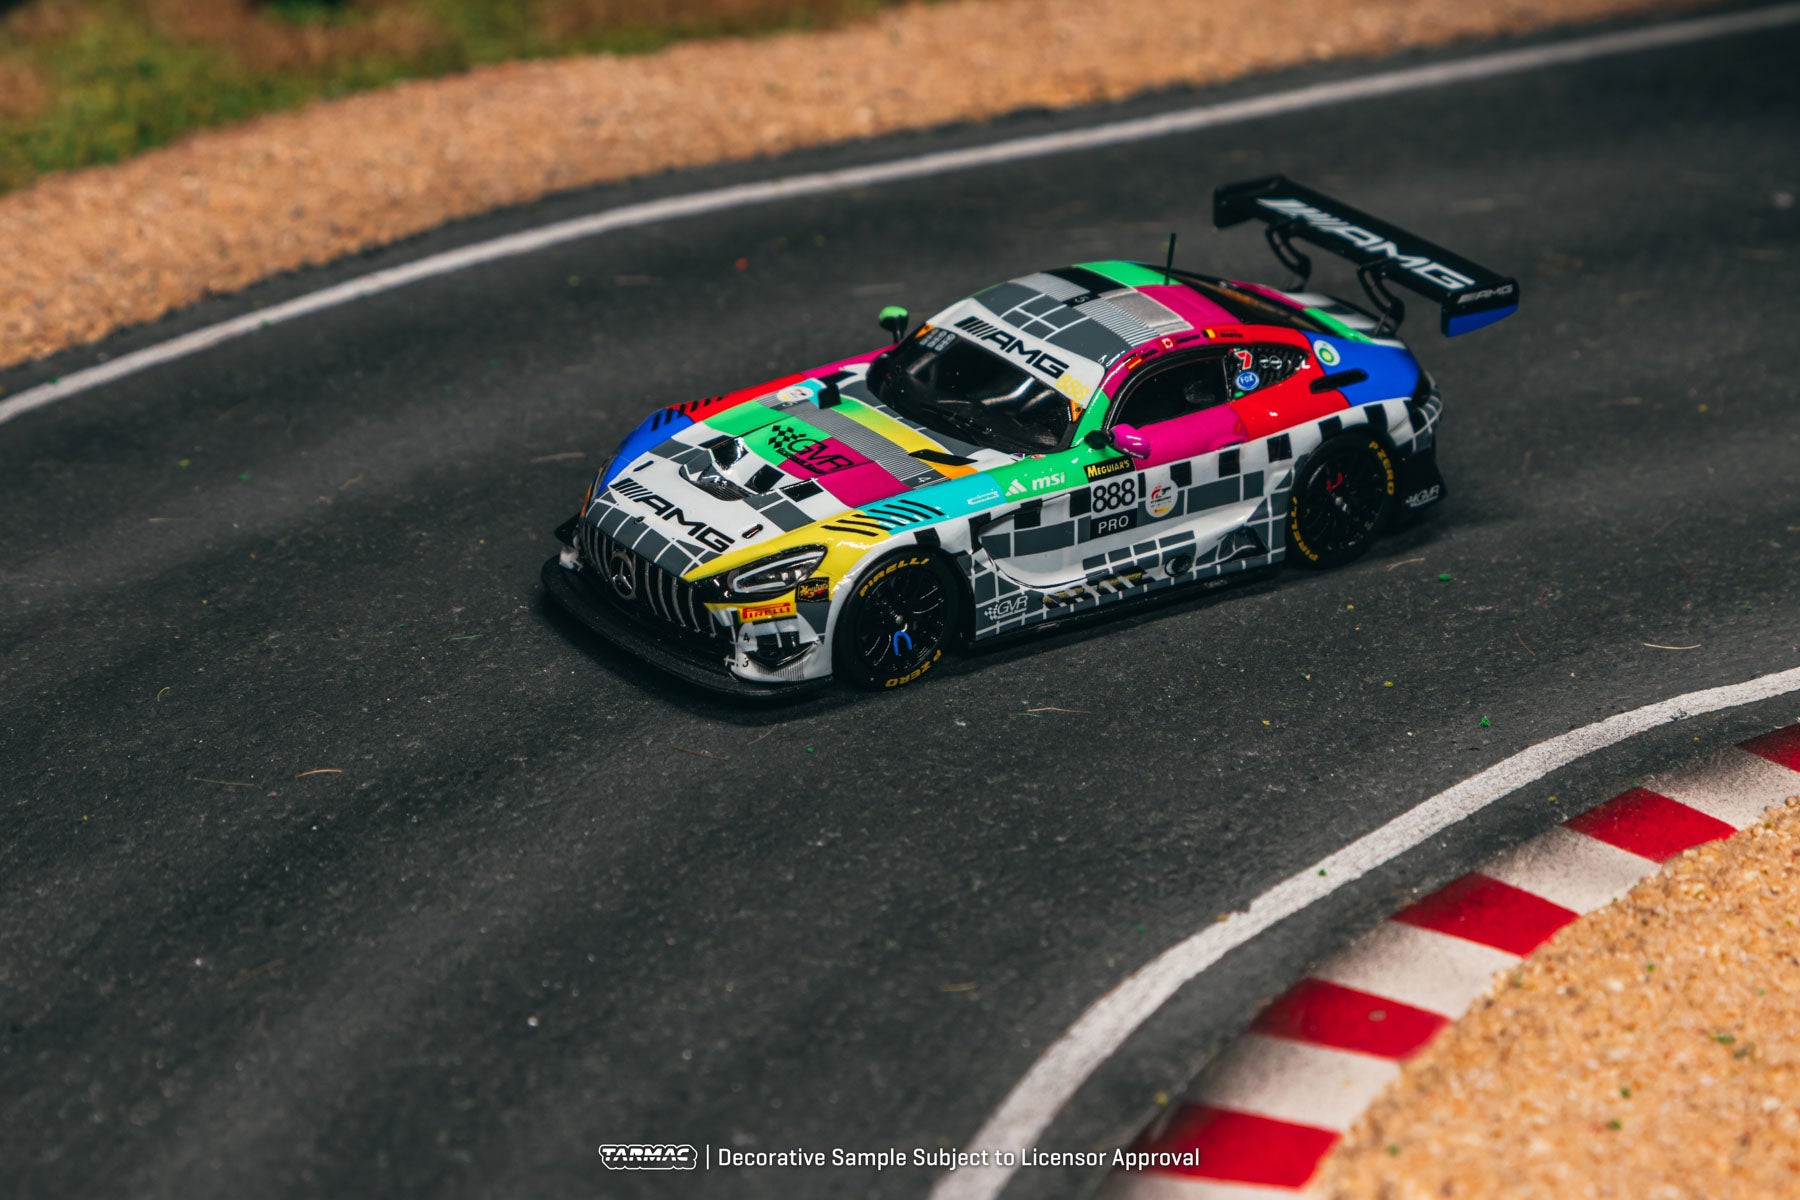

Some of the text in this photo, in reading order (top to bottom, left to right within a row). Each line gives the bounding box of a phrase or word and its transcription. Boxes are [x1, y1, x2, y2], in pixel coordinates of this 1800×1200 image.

[1327, 225, 1476, 290] AMG
[980, 330, 1070, 380] AMG
[1055, 373, 1091, 401] 888
[1239, 373, 1254, 385] FOX
[786, 437, 855, 472] GVR
[1087, 459, 1130, 478] MEGUIAR'S
[1368, 440, 1395, 495] P ZERO
[1031, 471, 1066, 491] msi
[1092, 477, 1136, 513] 888
[632, 493, 736, 553] AMG
[1097, 515, 1129, 535] PRO
[1290, 495, 1319, 561] PIRELLI
[858, 556, 930, 598] PIRELLI
[742, 602, 791, 620] PIRELLI
[997, 595, 1029, 615] GVR
[885, 648, 942, 688] P ZERO
